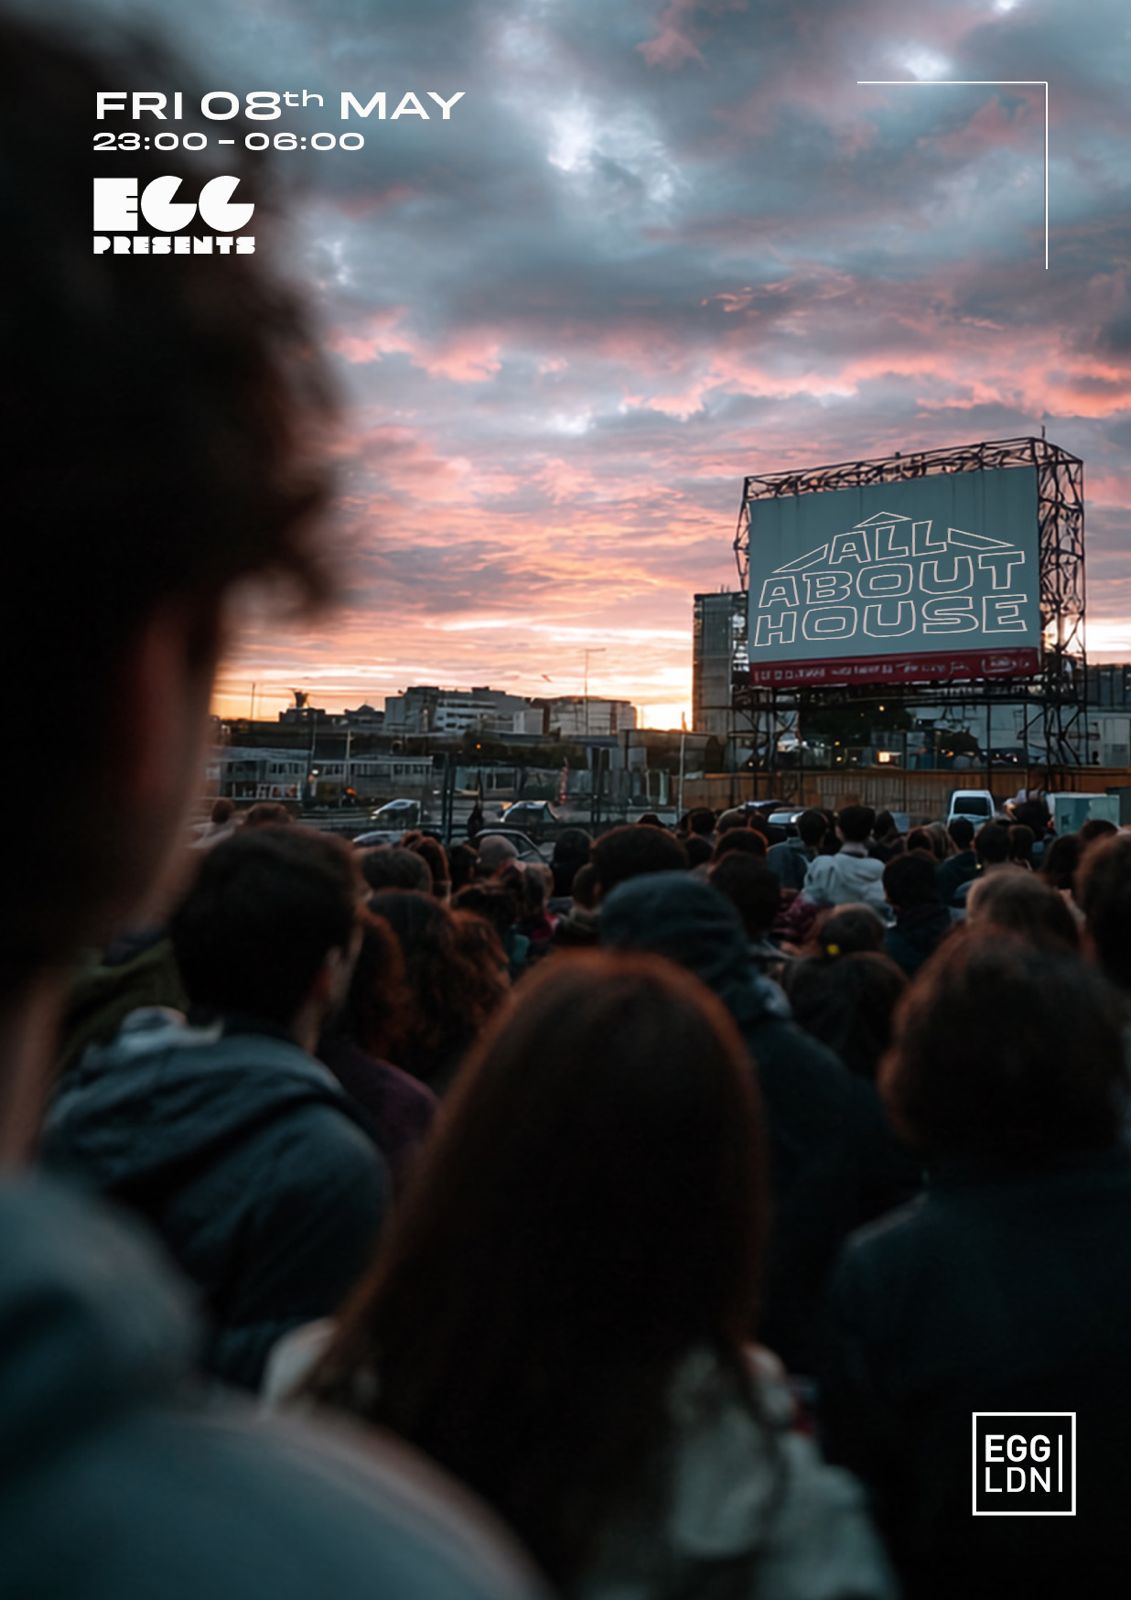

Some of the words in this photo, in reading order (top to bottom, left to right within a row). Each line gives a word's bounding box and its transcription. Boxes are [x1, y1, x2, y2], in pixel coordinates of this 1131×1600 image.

[828, 520, 948, 565] ALL
[758, 551, 1025, 608] ABOUT
[754, 594, 1028, 647] HOUSE
